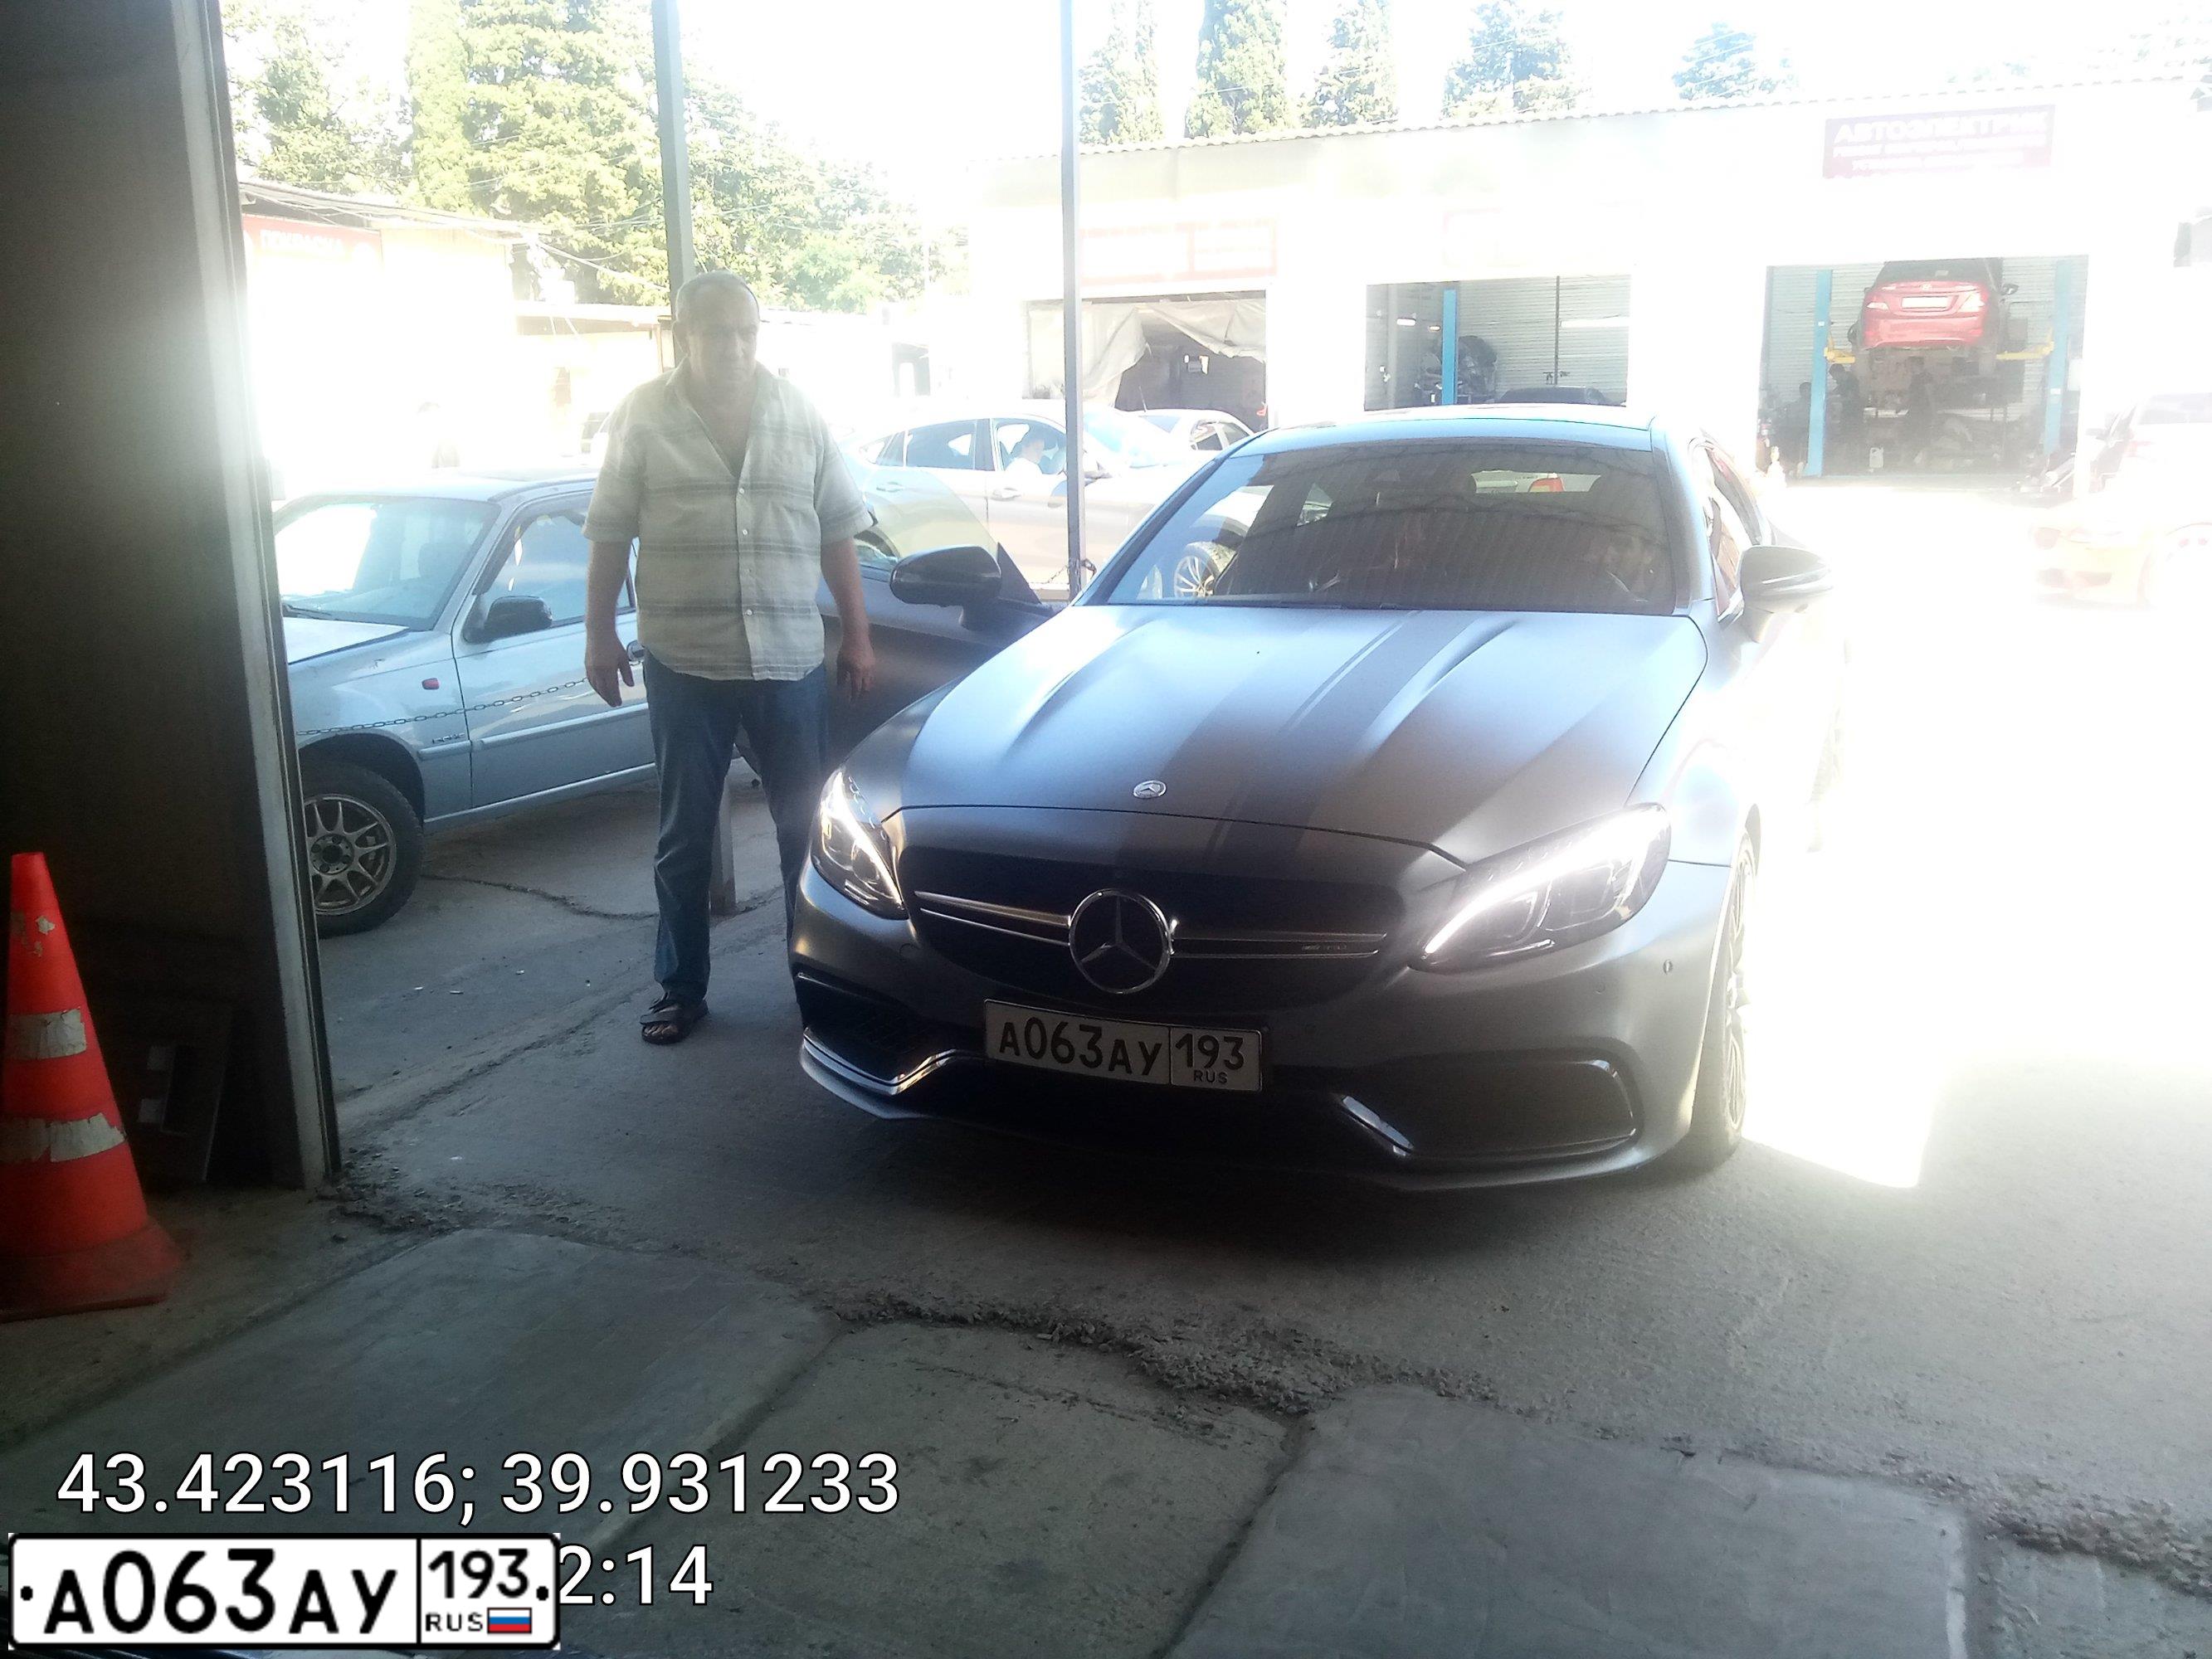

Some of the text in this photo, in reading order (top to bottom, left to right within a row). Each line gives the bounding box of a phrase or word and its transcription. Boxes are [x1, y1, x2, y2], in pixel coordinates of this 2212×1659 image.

[999, 1017, 1245, 1075] А063АУ 193
[1193, 1069, 1228, 1084] RUS
